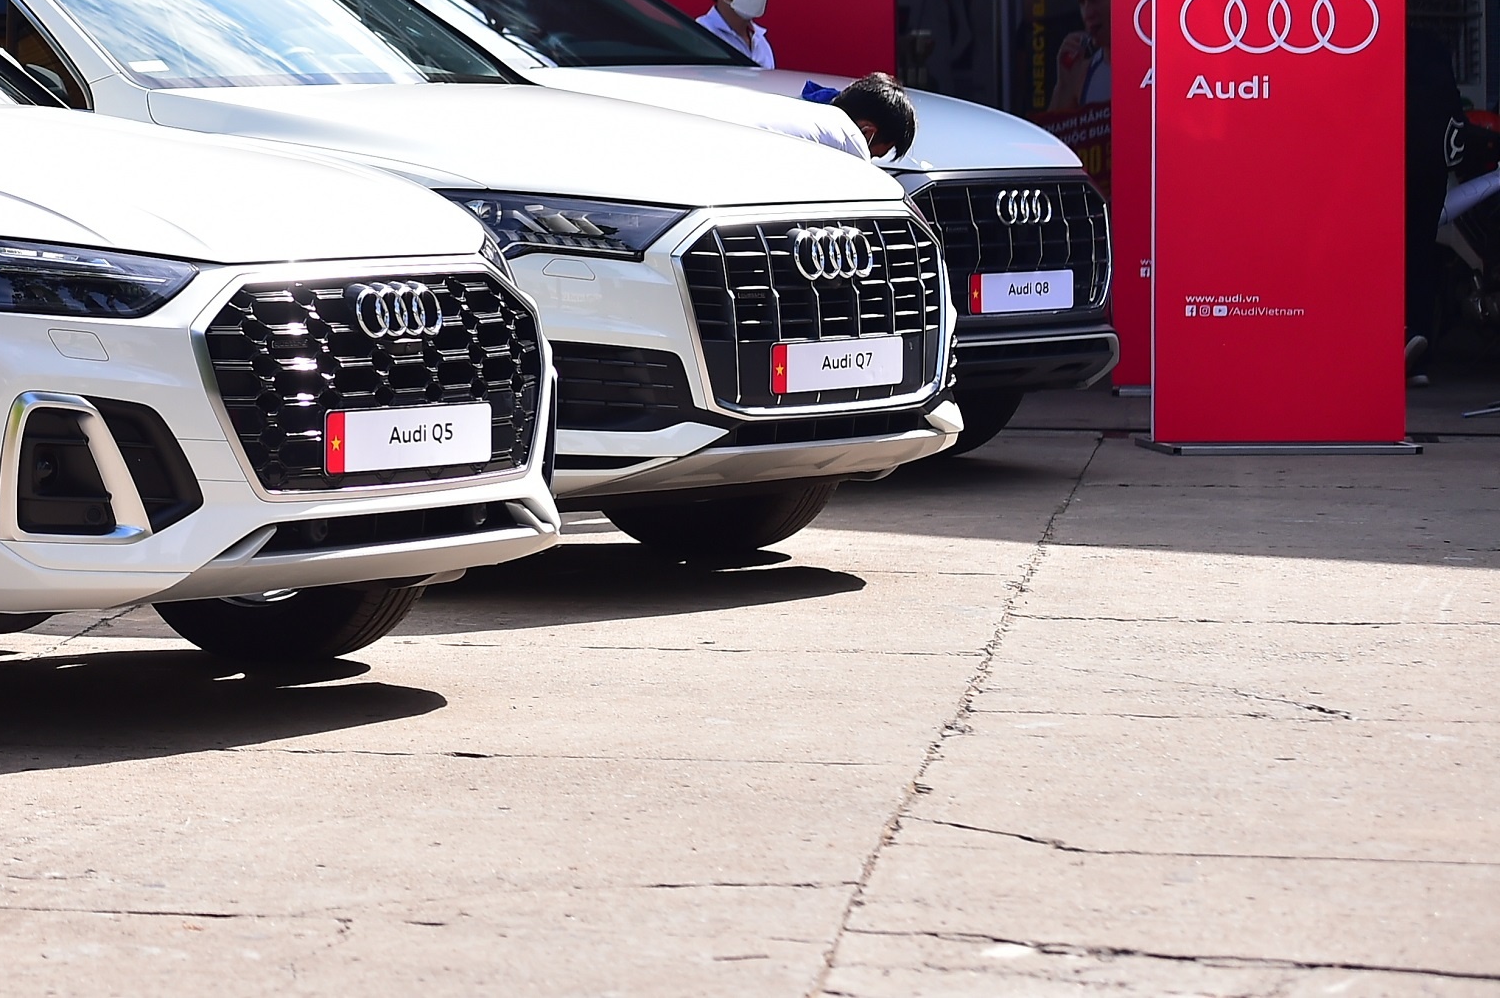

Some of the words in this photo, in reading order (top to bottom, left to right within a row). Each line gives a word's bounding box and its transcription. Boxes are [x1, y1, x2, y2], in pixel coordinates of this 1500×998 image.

[1186, 75, 1269, 99] Audi
[1008, 282, 1032, 296] Audi
[1035, 281, 1049, 296] Q8
[1185, 294, 1260, 303] www.audi.vn
[1228, 307, 1304, 316] /AudiVietnam
[821, 354, 851, 371] Audi
[855, 352, 873, 369] Q7
[389, 425, 427, 445] Audi
[432, 423, 453, 443] Q5
